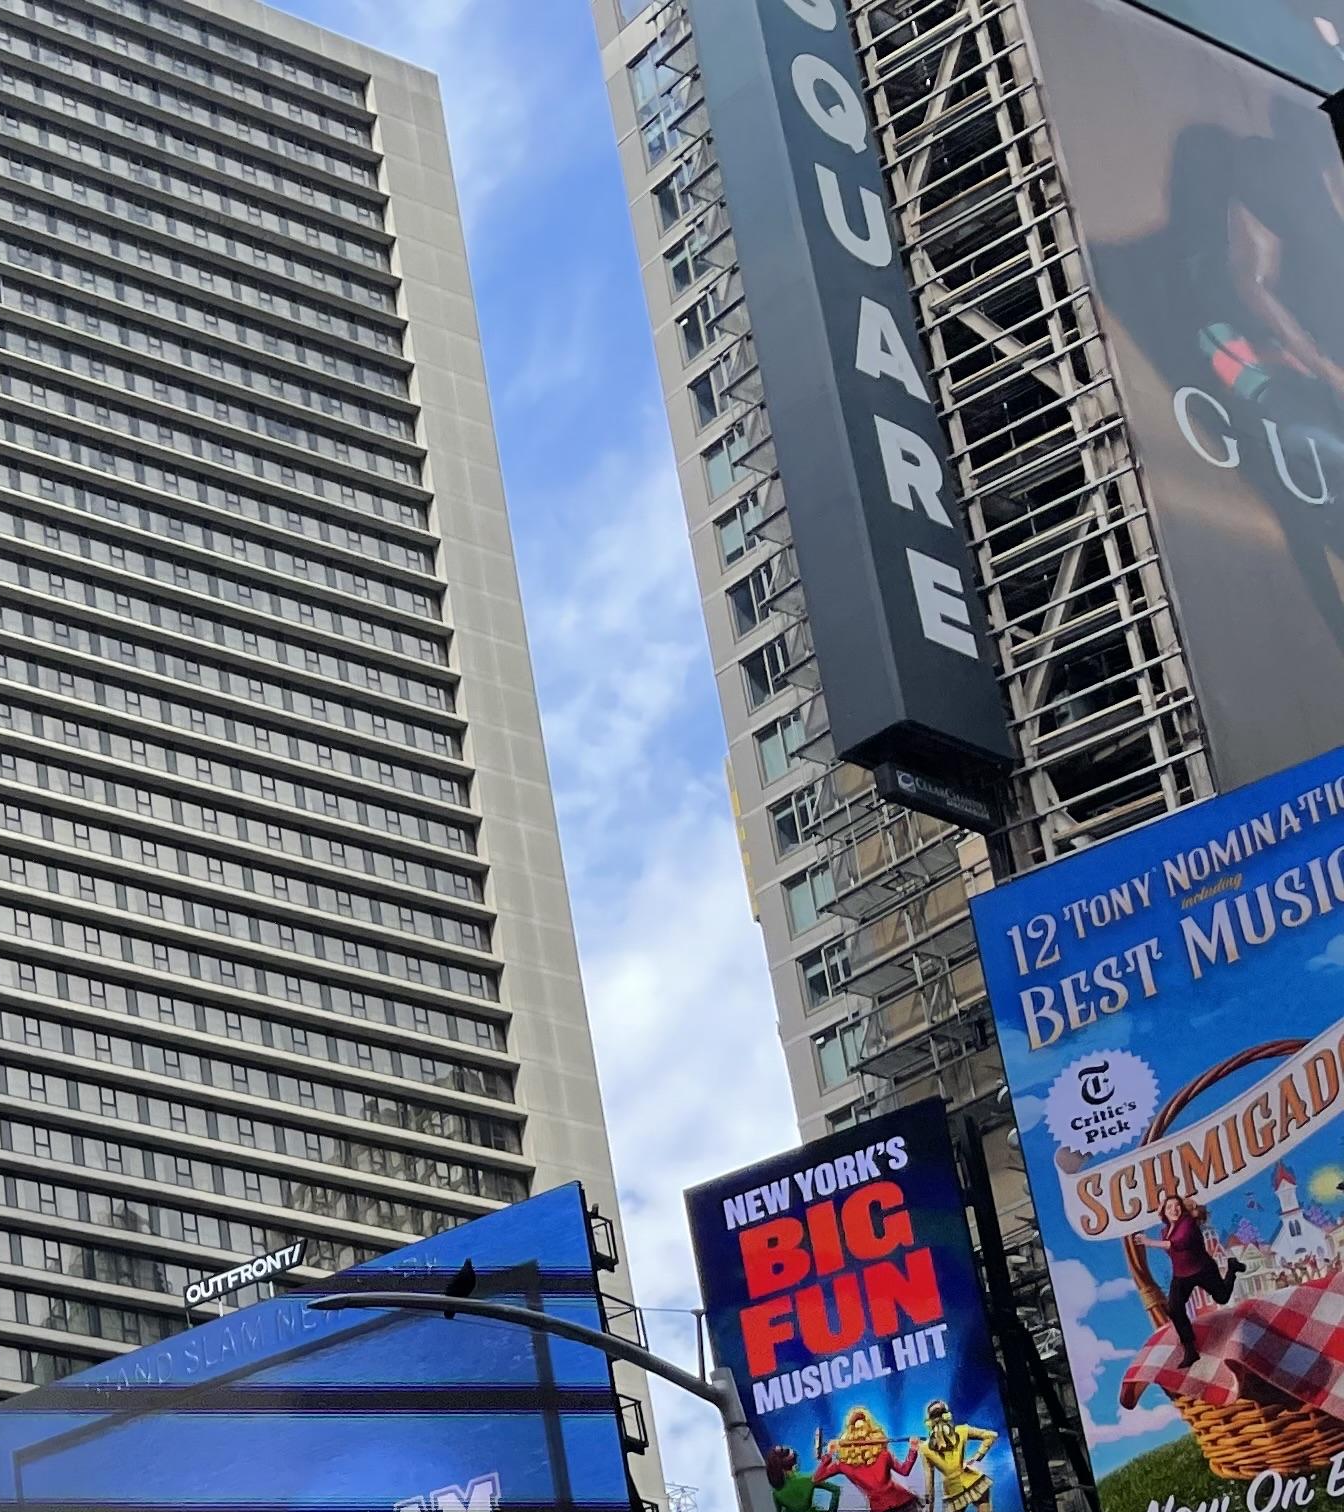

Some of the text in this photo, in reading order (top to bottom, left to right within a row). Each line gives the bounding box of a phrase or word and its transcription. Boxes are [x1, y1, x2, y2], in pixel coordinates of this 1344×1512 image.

[1007, 774, 1344, 976] 12 TONY NOMINATI
[1019, 937, 1163, 1051] BEST
[1070, 1100, 1137, 1132] Critic's
[1084, 1119, 1131, 1145] Pick
[723, 1135, 910, 1231] NEW YORK'S
[738, 1180, 915, 1300] BIG
[739, 1247, 945, 1378] FUN
[752, 1323, 948, 1415] MUSICAL HIT
